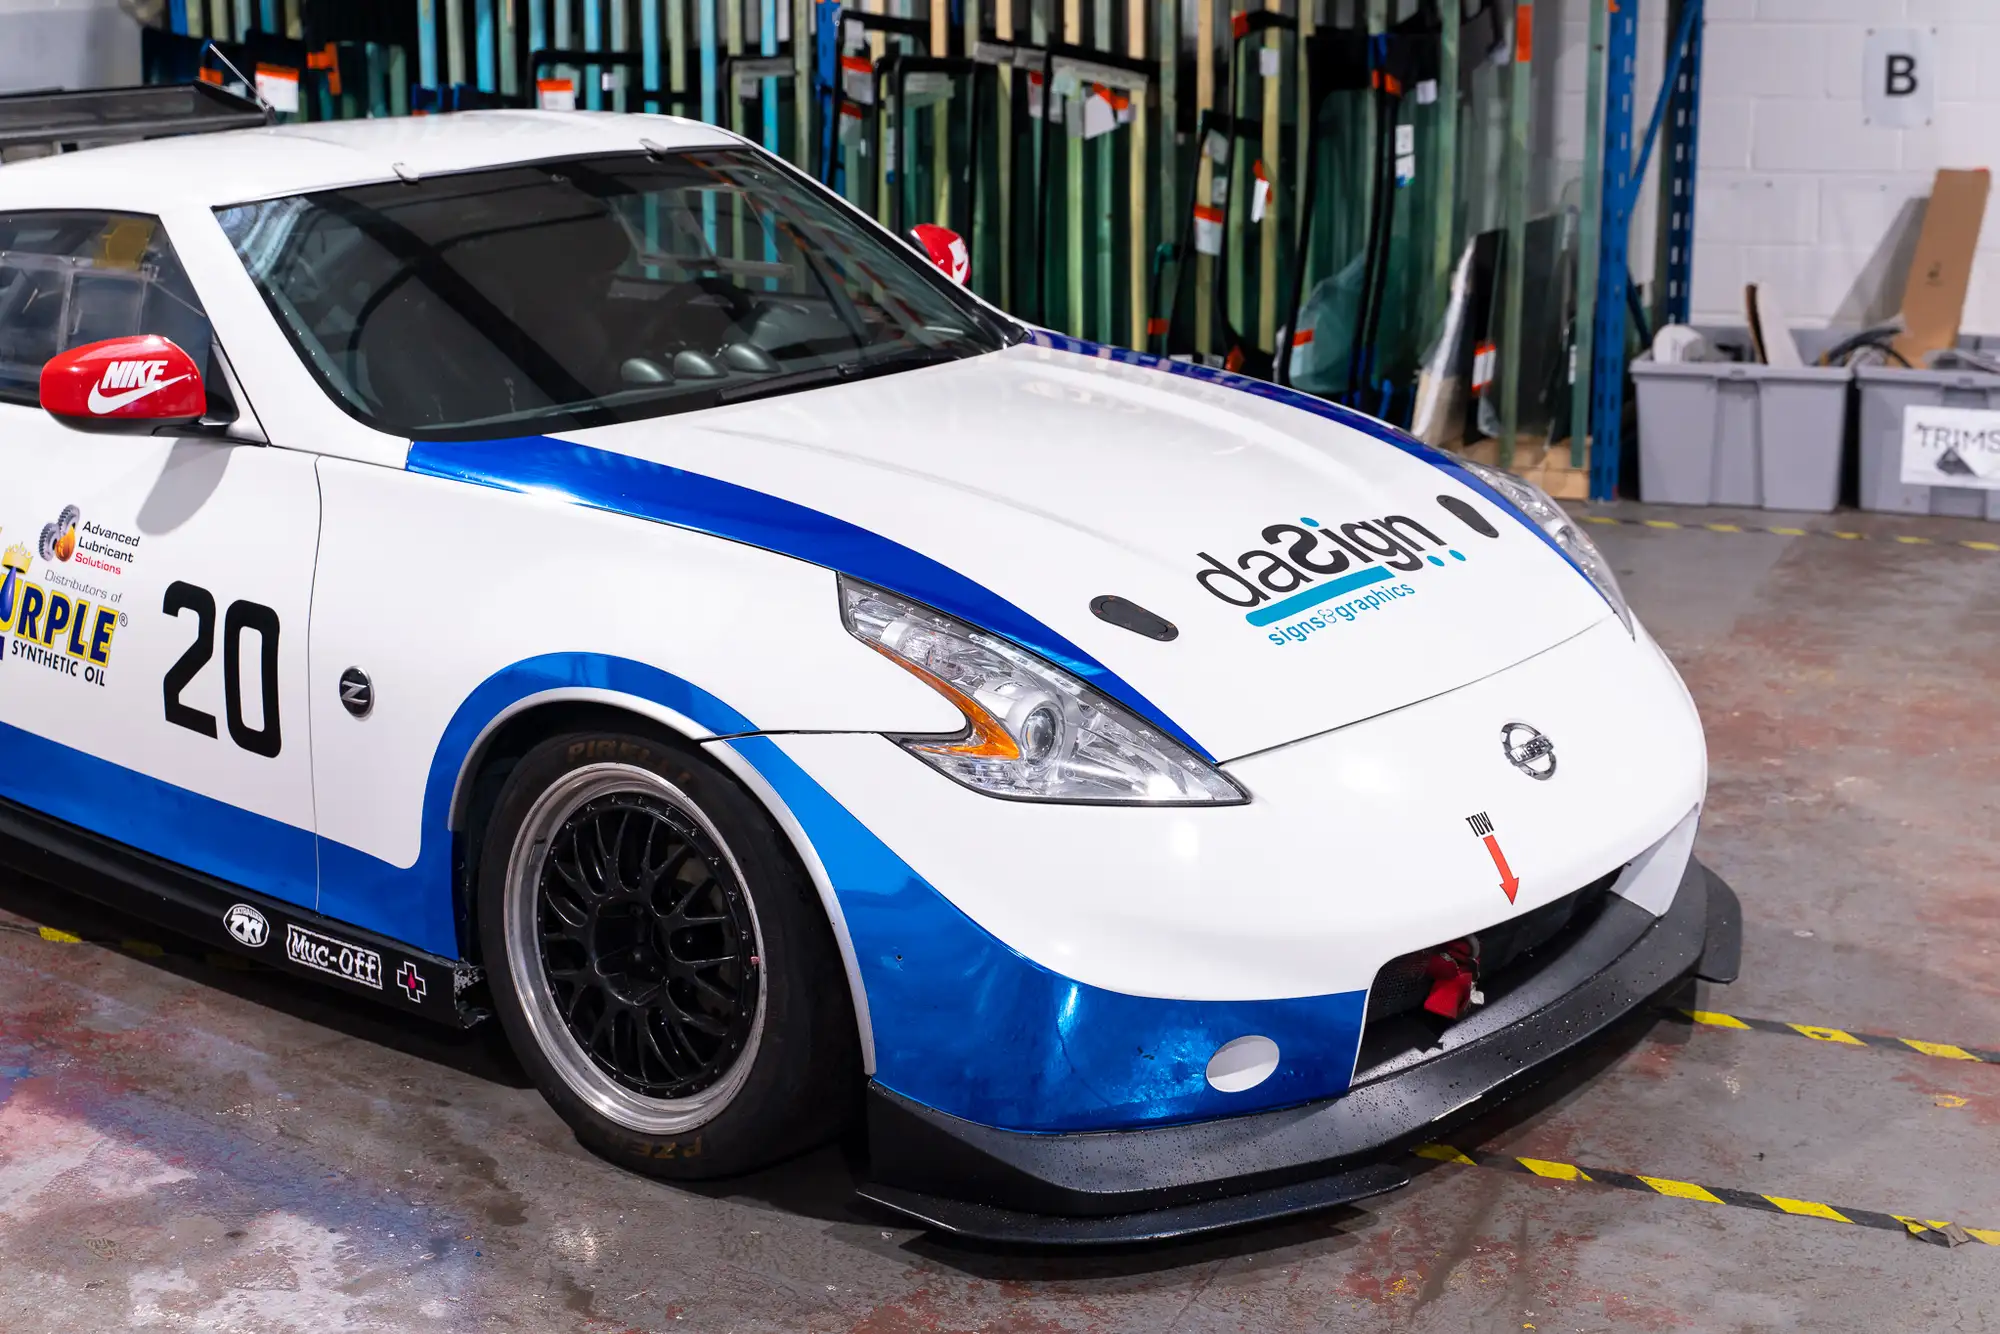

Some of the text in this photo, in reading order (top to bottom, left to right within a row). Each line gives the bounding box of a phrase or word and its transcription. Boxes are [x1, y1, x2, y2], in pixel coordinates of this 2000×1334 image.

[1885, 54, 1918, 95] B
[101, 360, 169, 389] NIKE
[82, 521, 141, 547] Advanced
[75, 552, 121, 575] Solutions
[78, 536, 134, 563] Lubricant
[45, 569, 123, 603] Distributors of
[12, 640, 105, 687] SYNTHETIC OIL
[162, 580, 282, 758] 20
[1465, 811, 1495, 837] TOW
